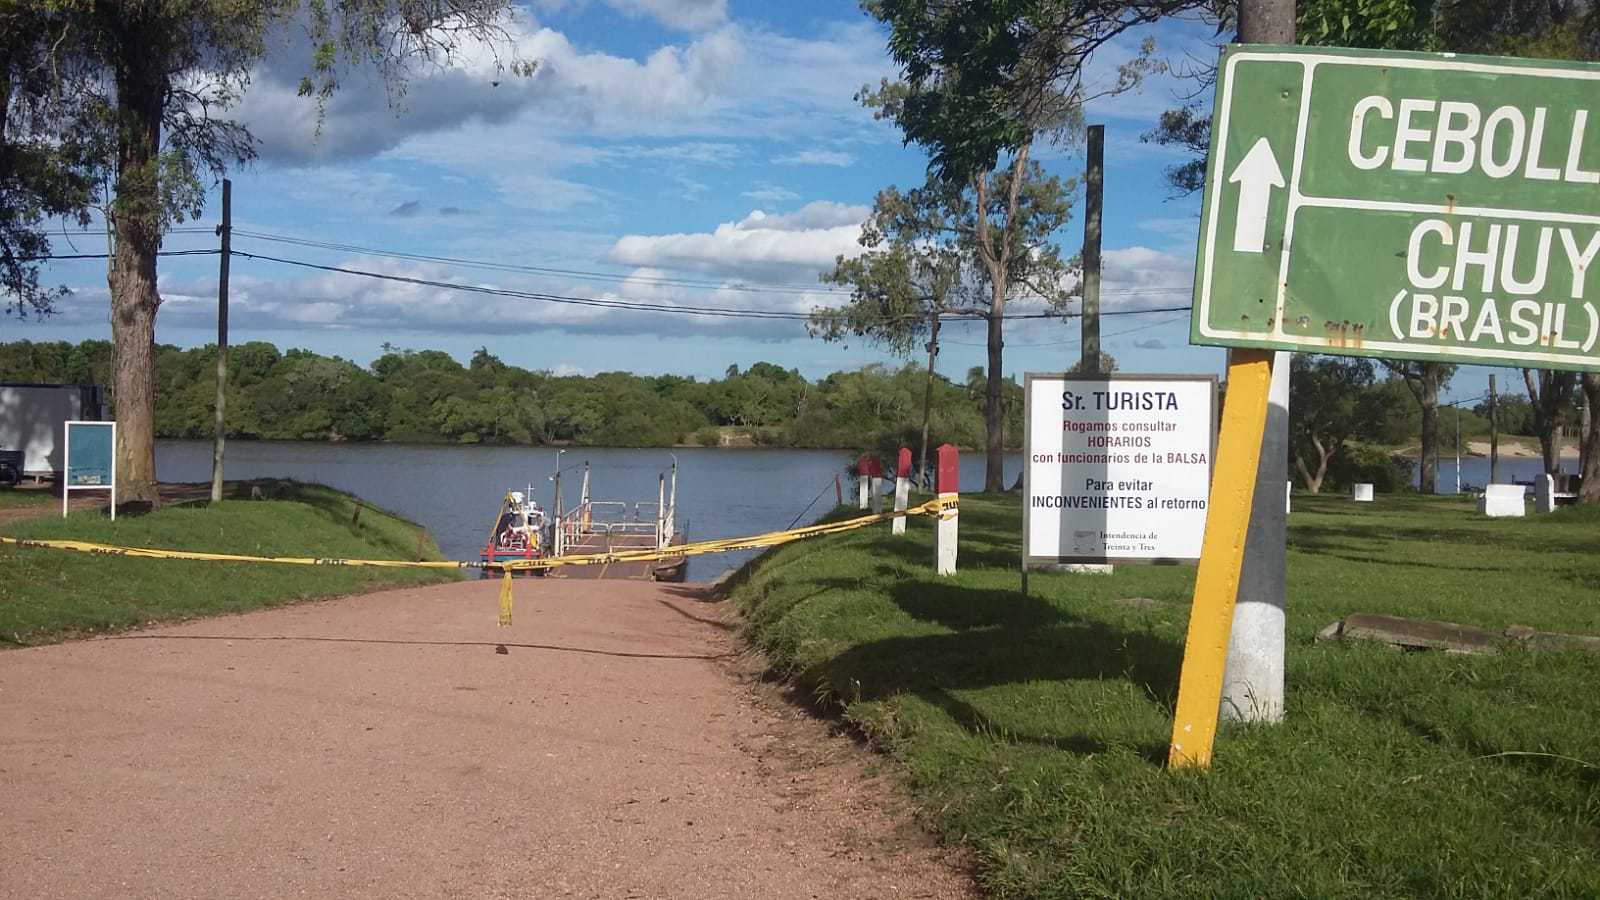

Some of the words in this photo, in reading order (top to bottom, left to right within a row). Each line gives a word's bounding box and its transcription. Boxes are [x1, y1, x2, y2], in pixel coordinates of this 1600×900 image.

[1348, 95, 1600, 183] CEBOLL
[1406, 219, 1600, 299] CHUY
[1389, 289, 1599, 352] (BRASIL)
[1061, 391, 1086, 410] Sr.
[1093, 391, 1178, 411] TURISTA
[1063, 420, 1118, 434] Rogamos
[1122, 420, 1177, 432] consultar
[1088, 436, 1151, 447] HORARIOS
[1032, 454, 1053, 463] con
[1057, 452, 1130, 464] funcionarios
[1134, 453, 1148, 464] de
[1152, 453, 1163, 464] la
[1167, 453, 1207, 464] BALSA
[1086, 478, 1114, 491] Para
[1118, 479, 1153, 491] evitar
[1032, 496, 1142, 509] INCONVENIENTES
[1147, 497, 1158, 509] al
[1161, 498, 1206, 510] retorno
[1100, 530, 1146, 539] Intendencia
[1148, 531, 1158, 539] de
[1102, 542, 1130, 551] Treinta
[1139, 543, 1155, 551] Tres
